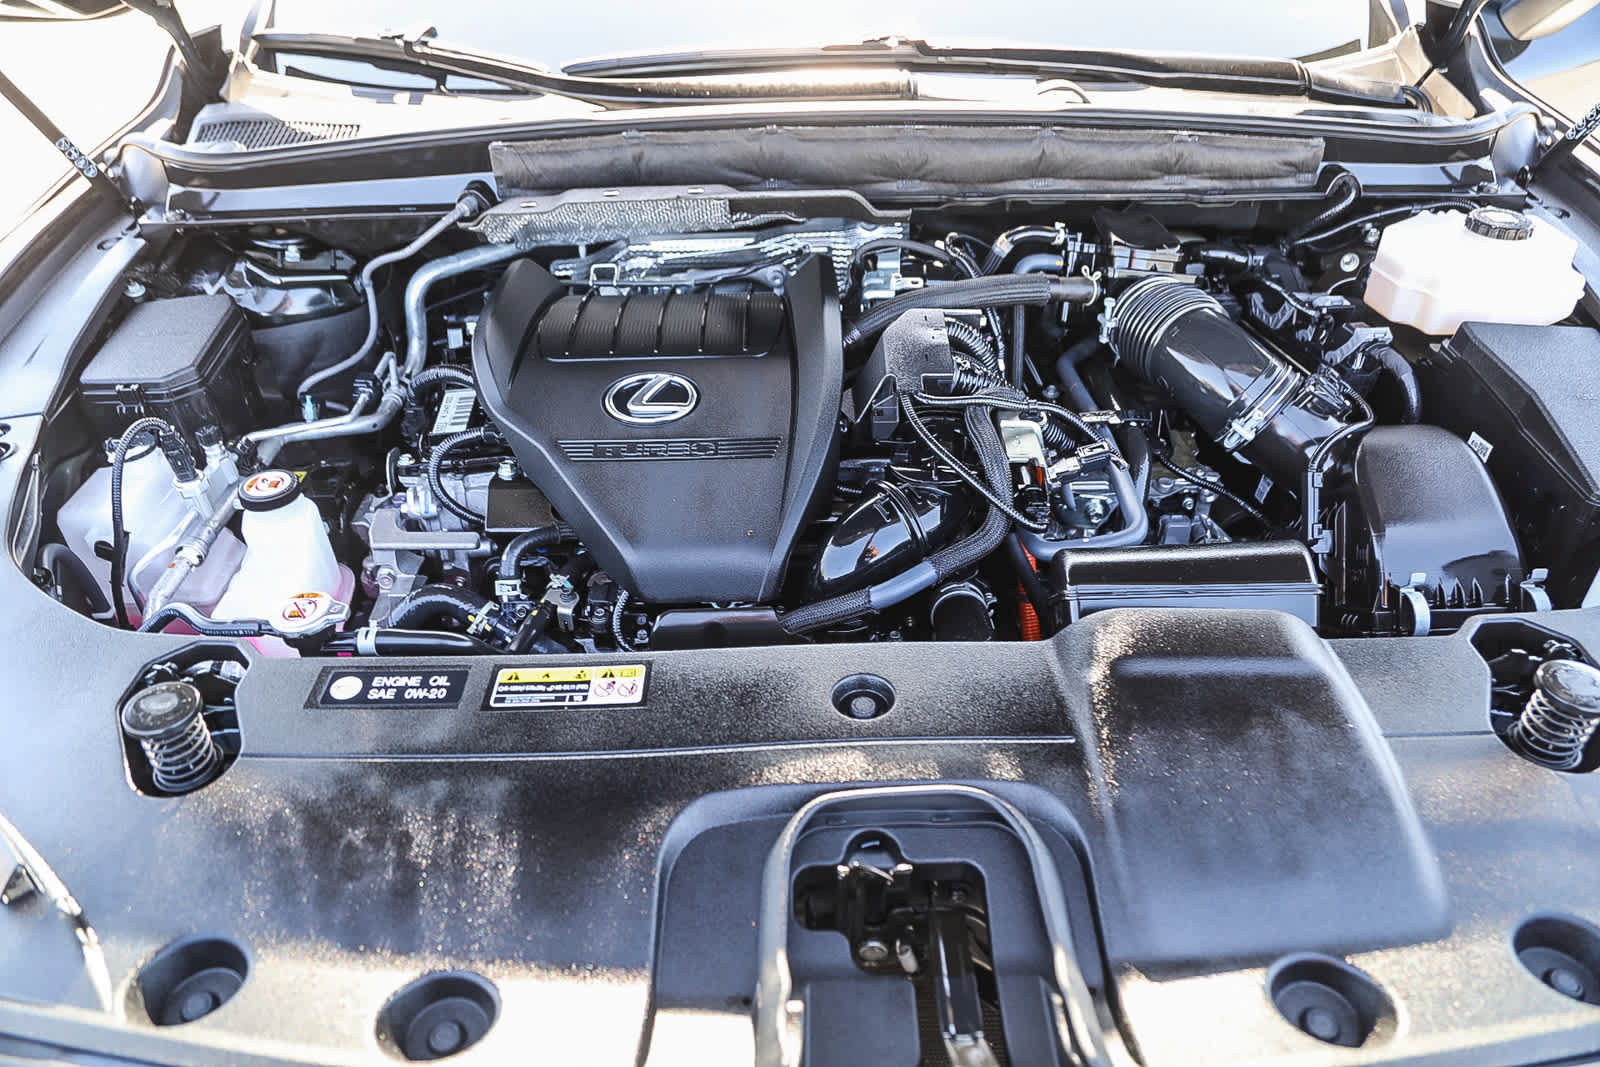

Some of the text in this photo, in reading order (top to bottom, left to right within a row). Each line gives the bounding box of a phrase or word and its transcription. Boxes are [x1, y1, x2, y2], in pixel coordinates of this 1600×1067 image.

[371, 675, 451, 687] ENGINE OIL
[367, 688, 448, 700] SAE 0W-20
